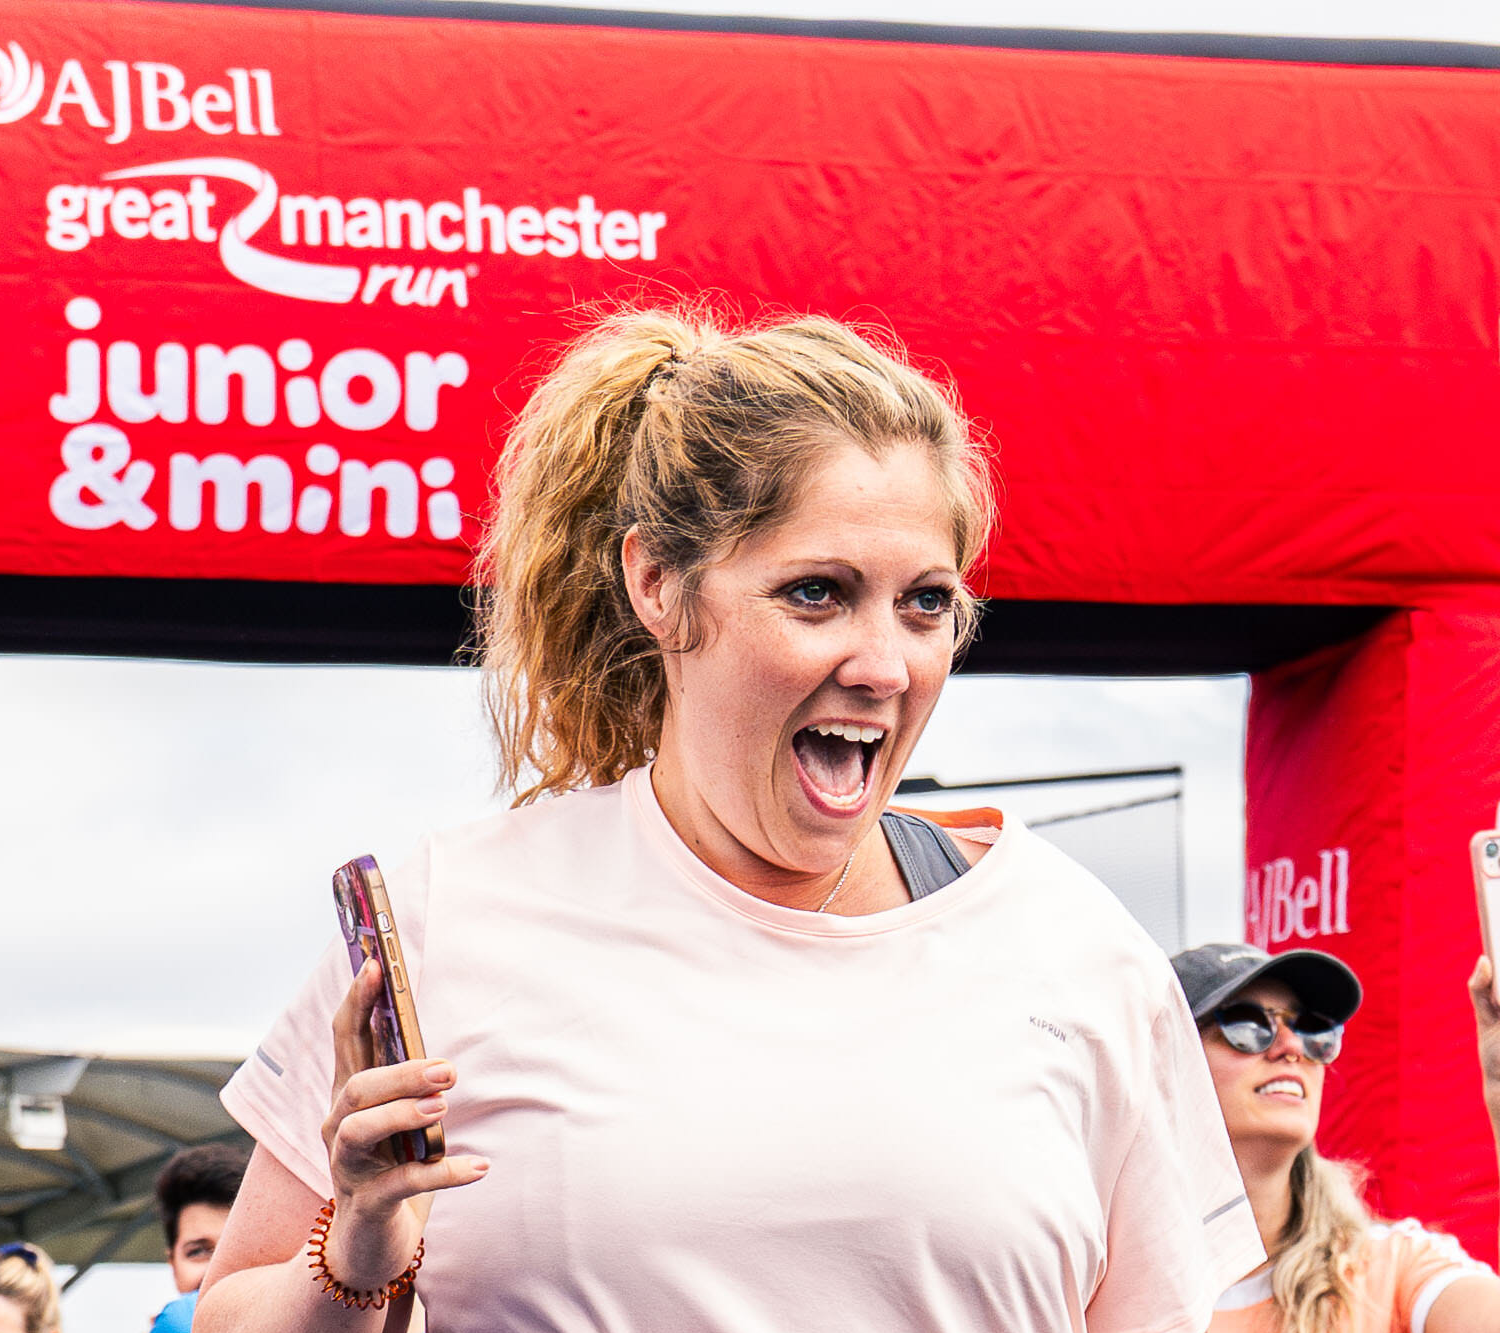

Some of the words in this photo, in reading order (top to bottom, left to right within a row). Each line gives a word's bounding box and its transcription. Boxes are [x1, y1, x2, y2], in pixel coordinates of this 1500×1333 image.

[46, 177, 218, 251] great
[280, 187, 666, 261] manchester
[360, 263, 469, 307] run
[49, 297, 468, 431] junior
[1029, 1015, 1067, 1043] KIPRUN
